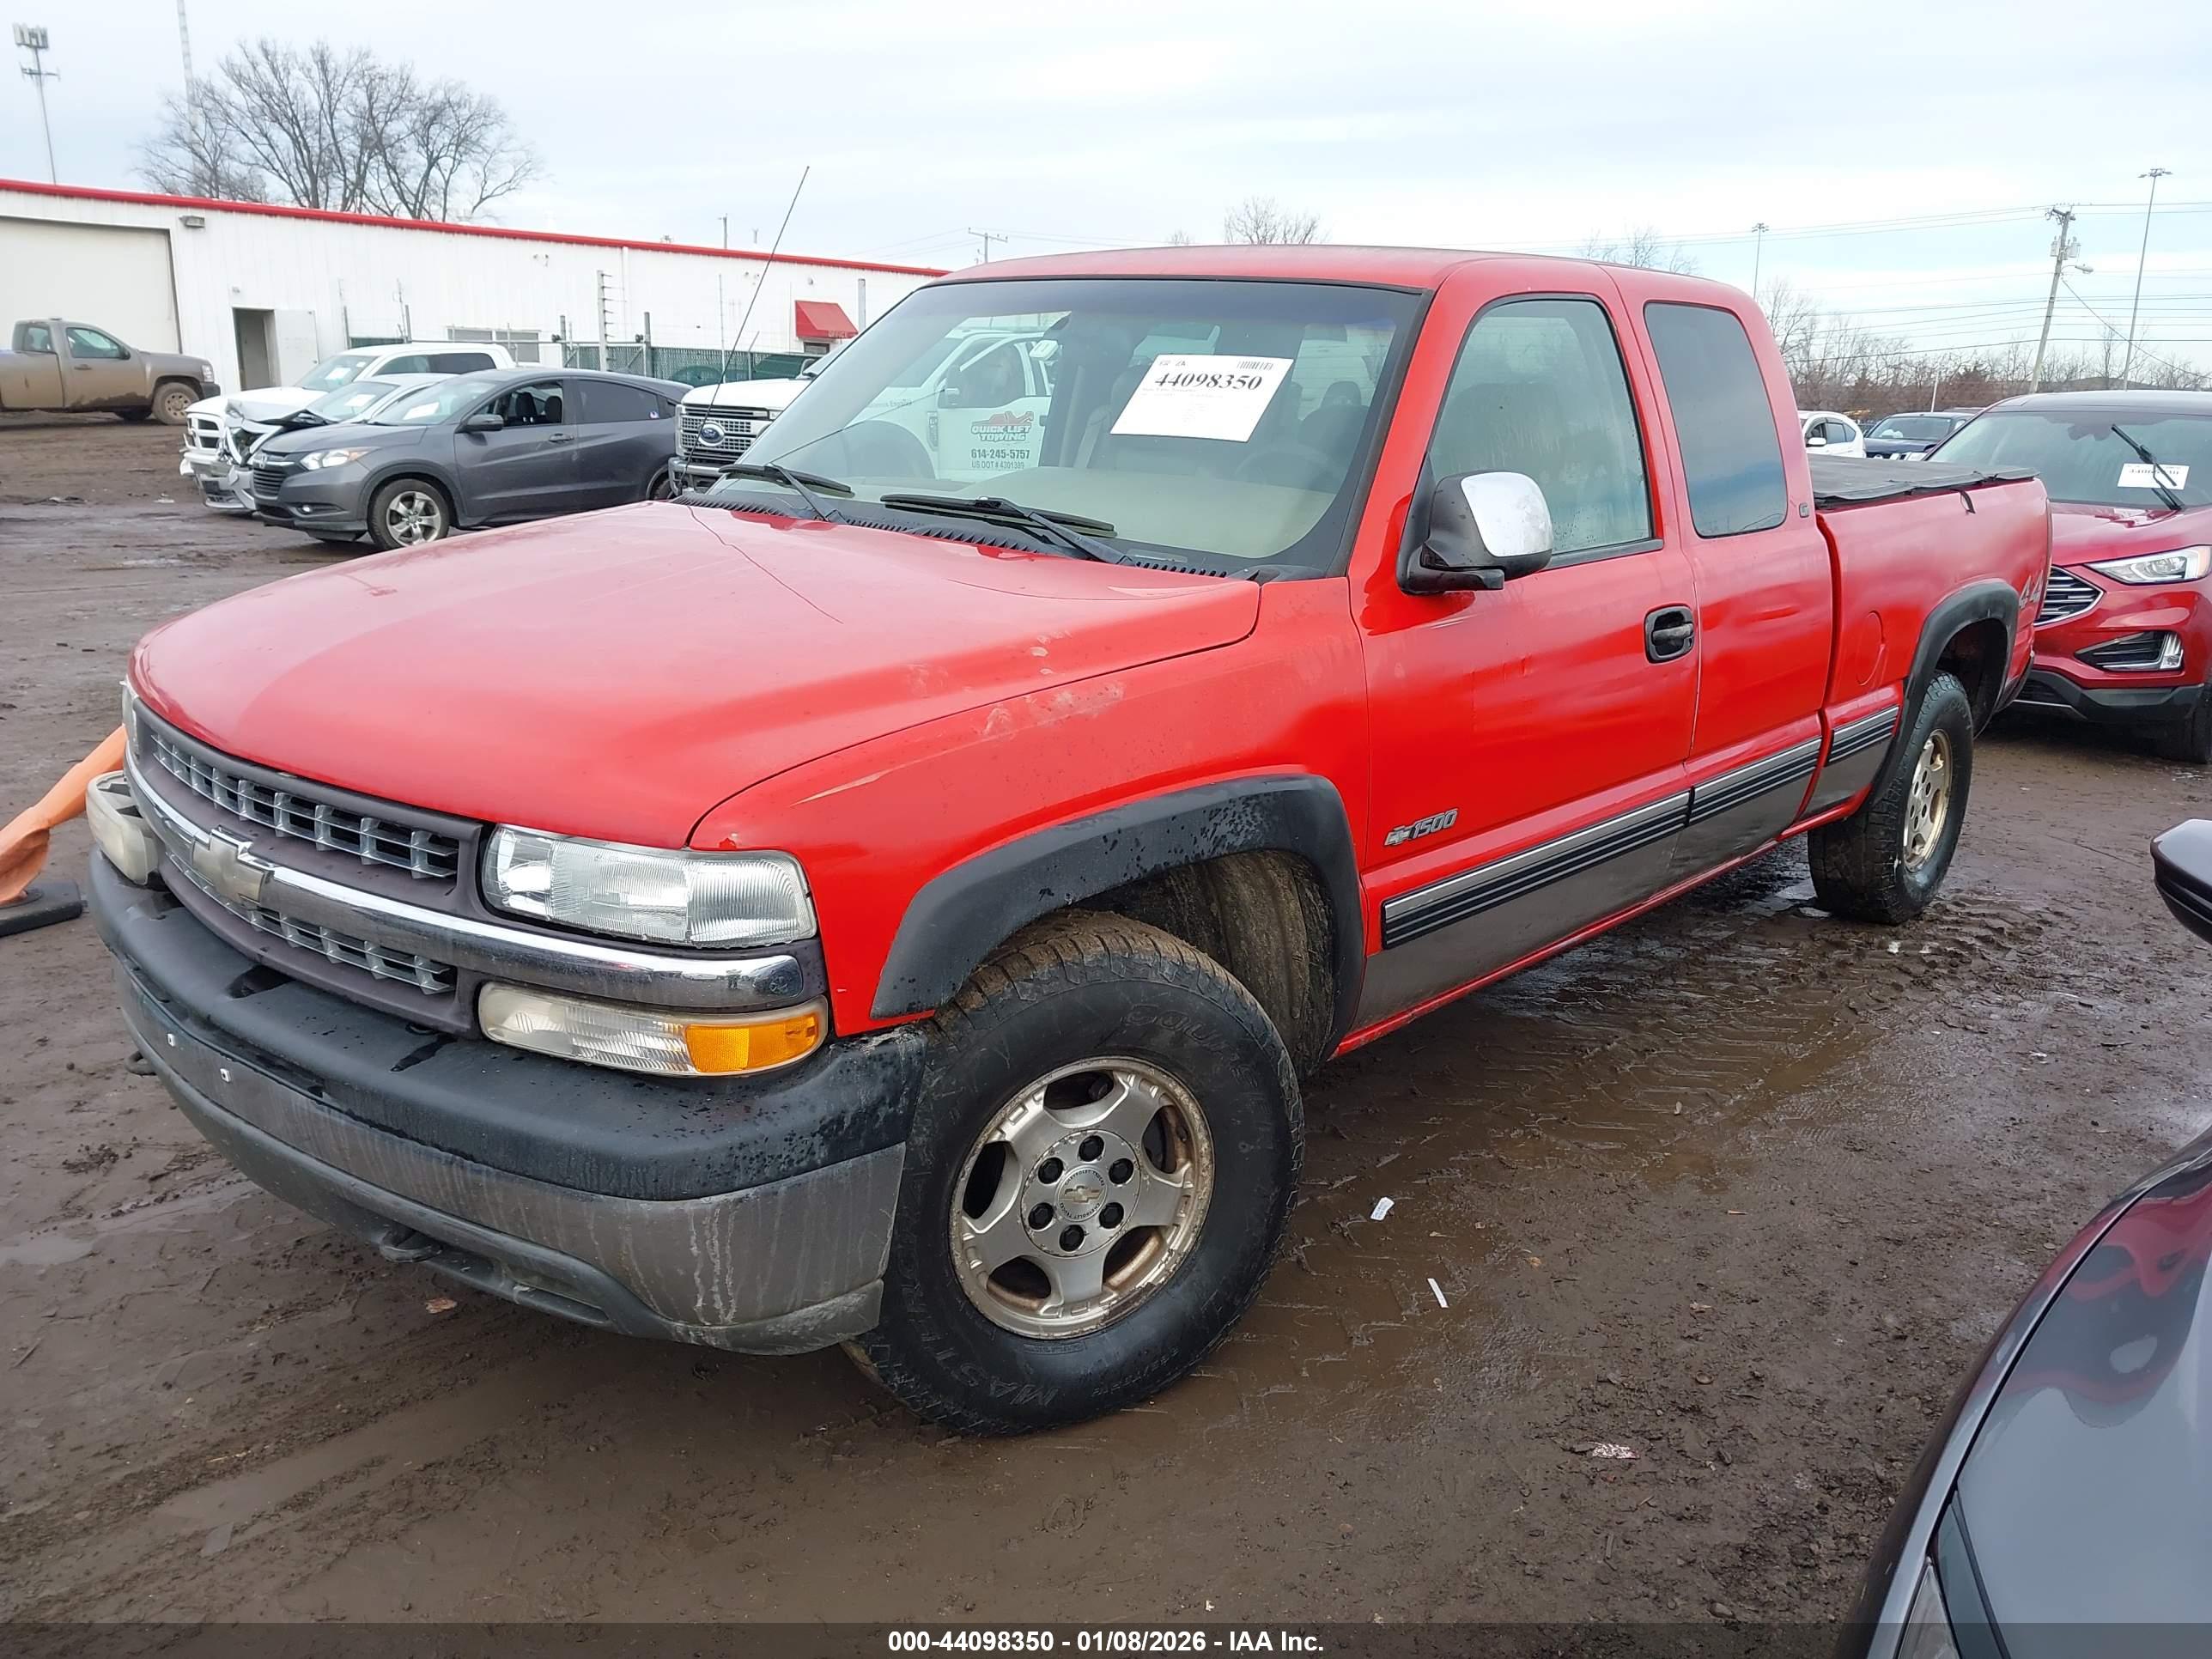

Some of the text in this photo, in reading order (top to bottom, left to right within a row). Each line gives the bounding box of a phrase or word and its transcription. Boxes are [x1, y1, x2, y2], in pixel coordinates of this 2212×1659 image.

[1155, 373, 1263, 390] 44098350
[979, 432, 1026, 442] TOWING
[971, 449, 1030, 459] 614-245-5757
[1413, 808, 1458, 839] 1500
